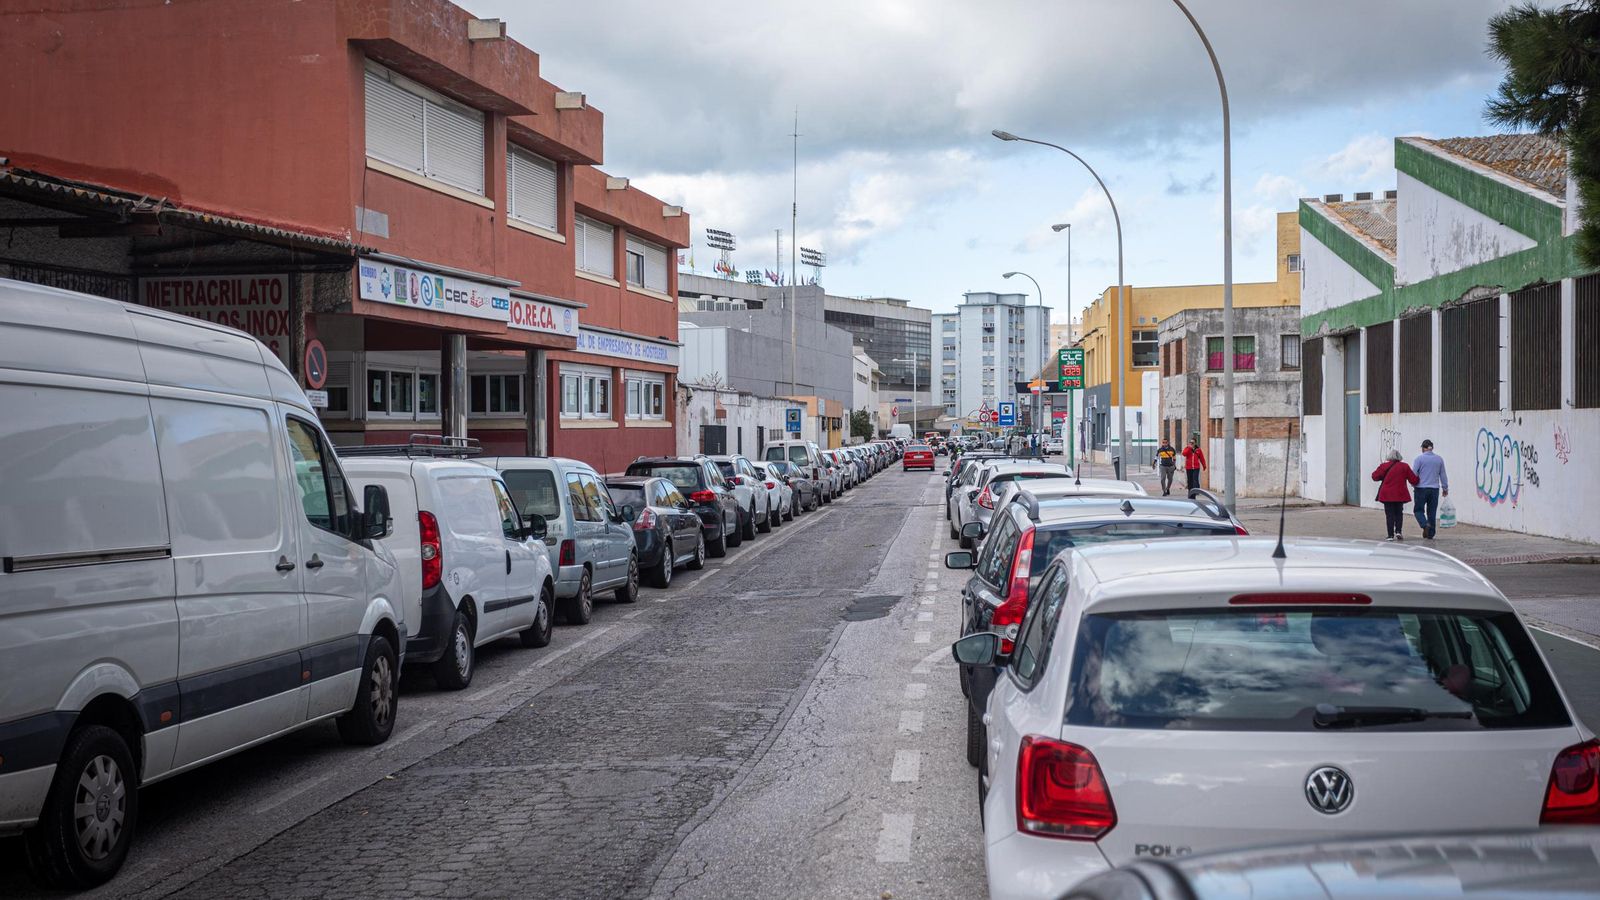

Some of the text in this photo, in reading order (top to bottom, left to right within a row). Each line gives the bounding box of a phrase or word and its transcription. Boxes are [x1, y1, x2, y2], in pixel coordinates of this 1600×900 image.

[146, 278, 282, 306] METRACRILATO
[598, 336, 633, 356] EMPRESARIOS
[634, 343, 641, 357] DE
